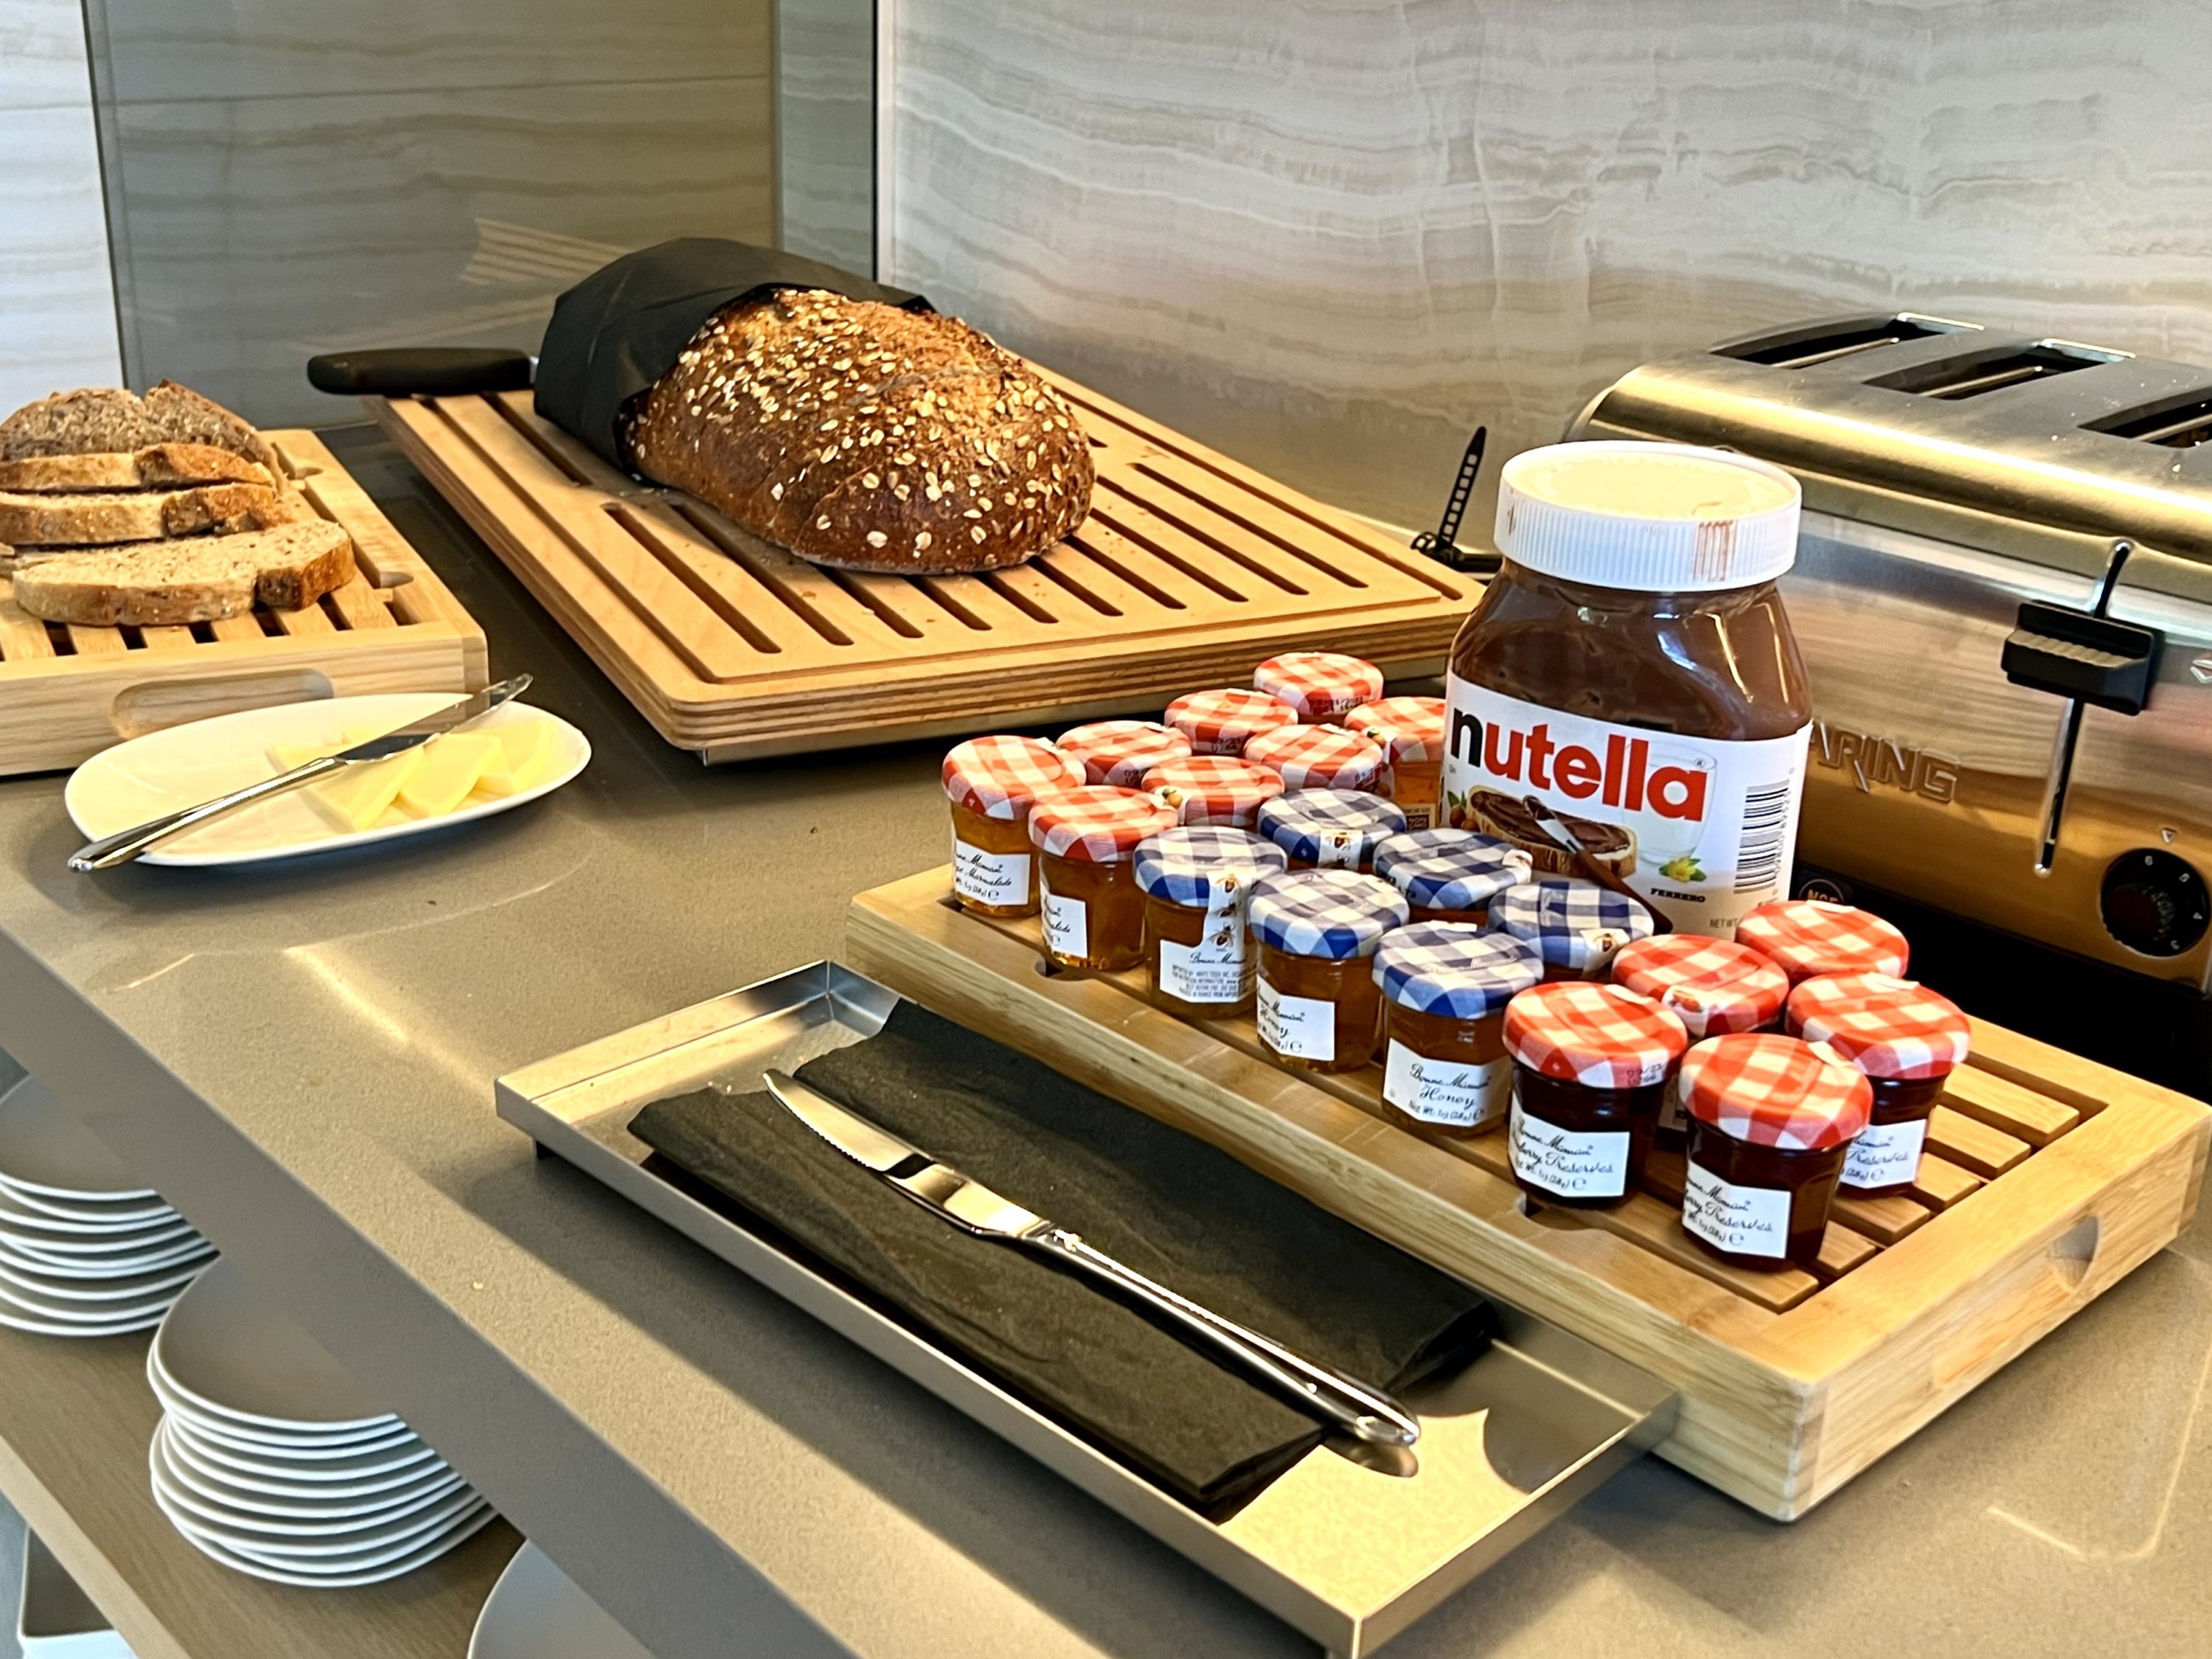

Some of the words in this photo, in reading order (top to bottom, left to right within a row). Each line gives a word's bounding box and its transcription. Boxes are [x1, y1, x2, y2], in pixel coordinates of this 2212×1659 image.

[1450, 707, 1708, 823] nutella
[1650, 888, 1706, 903] FERRERO
[1409, 1062, 1443, 1085] Bonne
[1419, 1085, 1475, 1110] Honey
[1545, 1134, 1592, 1156] Maman
[1545, 1151, 1614, 1174] Preserves
[1704, 1200, 1773, 1232] Preserves
